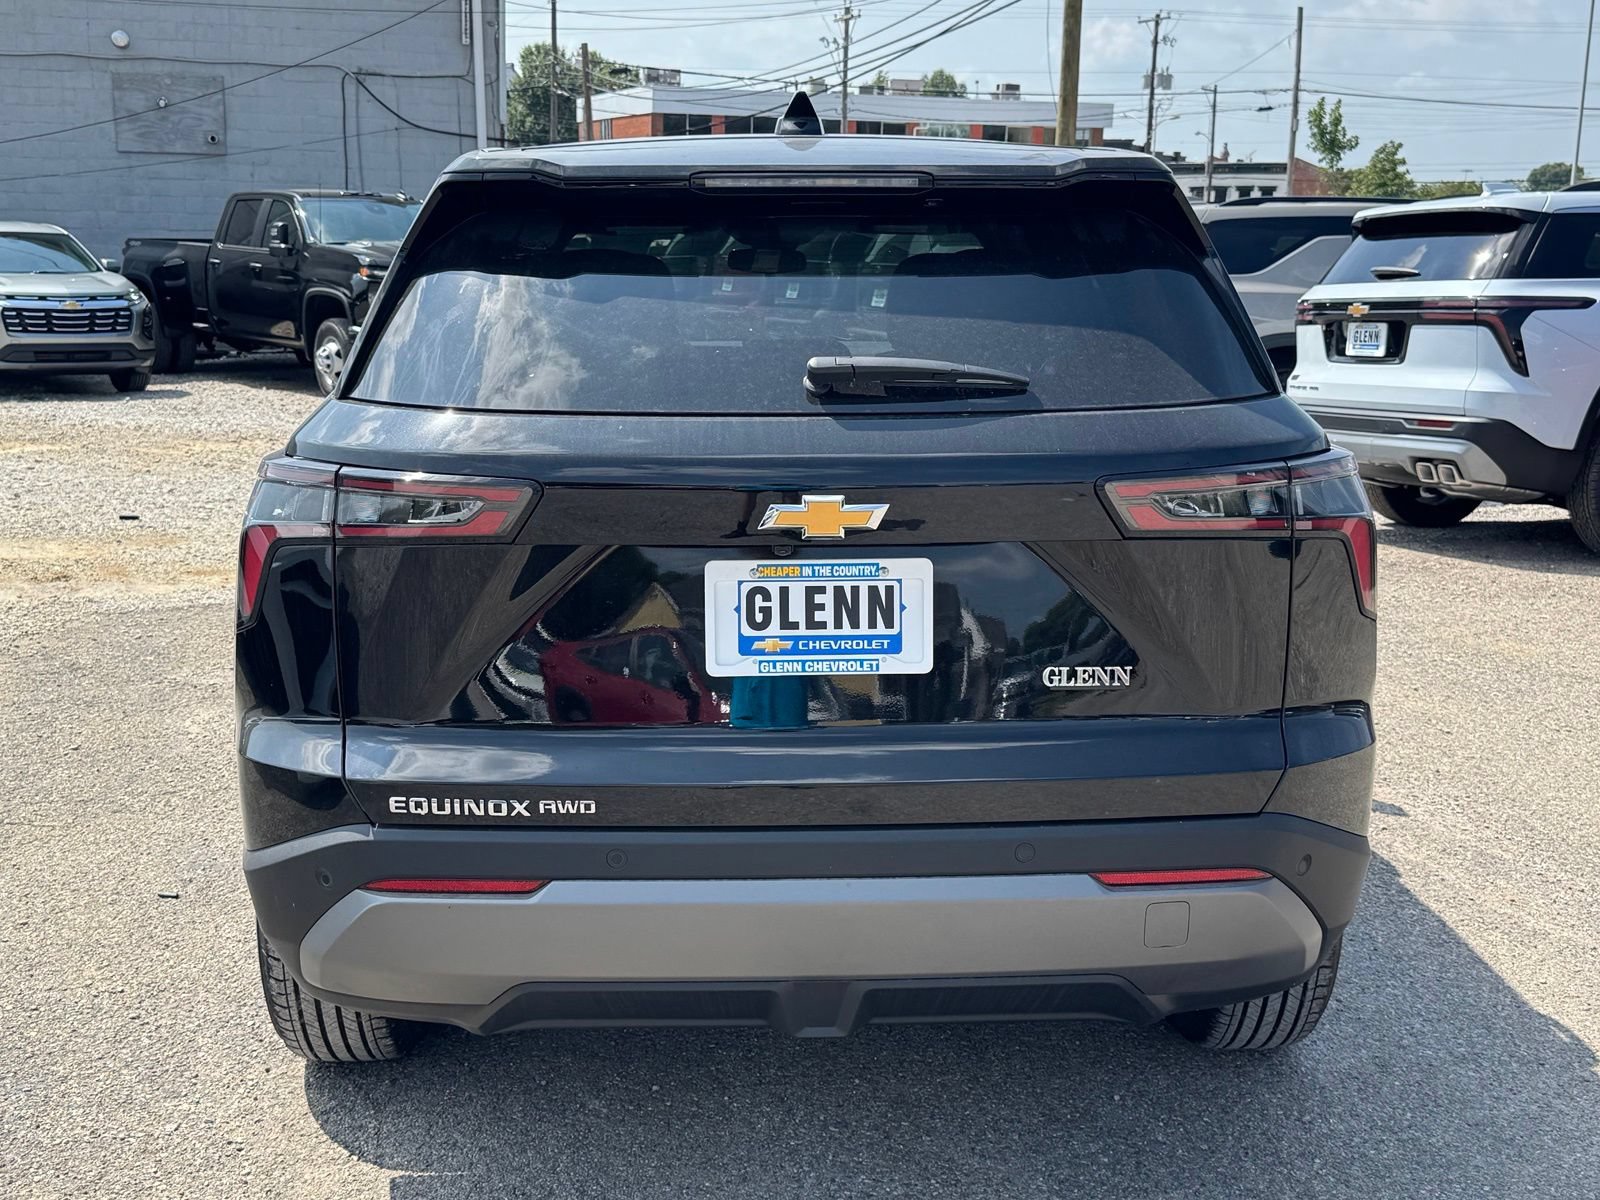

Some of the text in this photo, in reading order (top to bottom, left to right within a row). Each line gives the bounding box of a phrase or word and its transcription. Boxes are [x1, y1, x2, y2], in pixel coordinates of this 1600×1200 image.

[1353, 330, 1379, 343] GLENN
[757, 564, 879, 577] CHEAPER IN THE COUNTRY.
[745, 585, 895, 631] GLENN
[798, 639, 891, 650] CHEVROLET
[760, 660, 879, 673] GLENN CHEVROLET
[1042, 666, 1133, 687] GLENN
[389, 796, 597, 817] EQUINOX AWD
